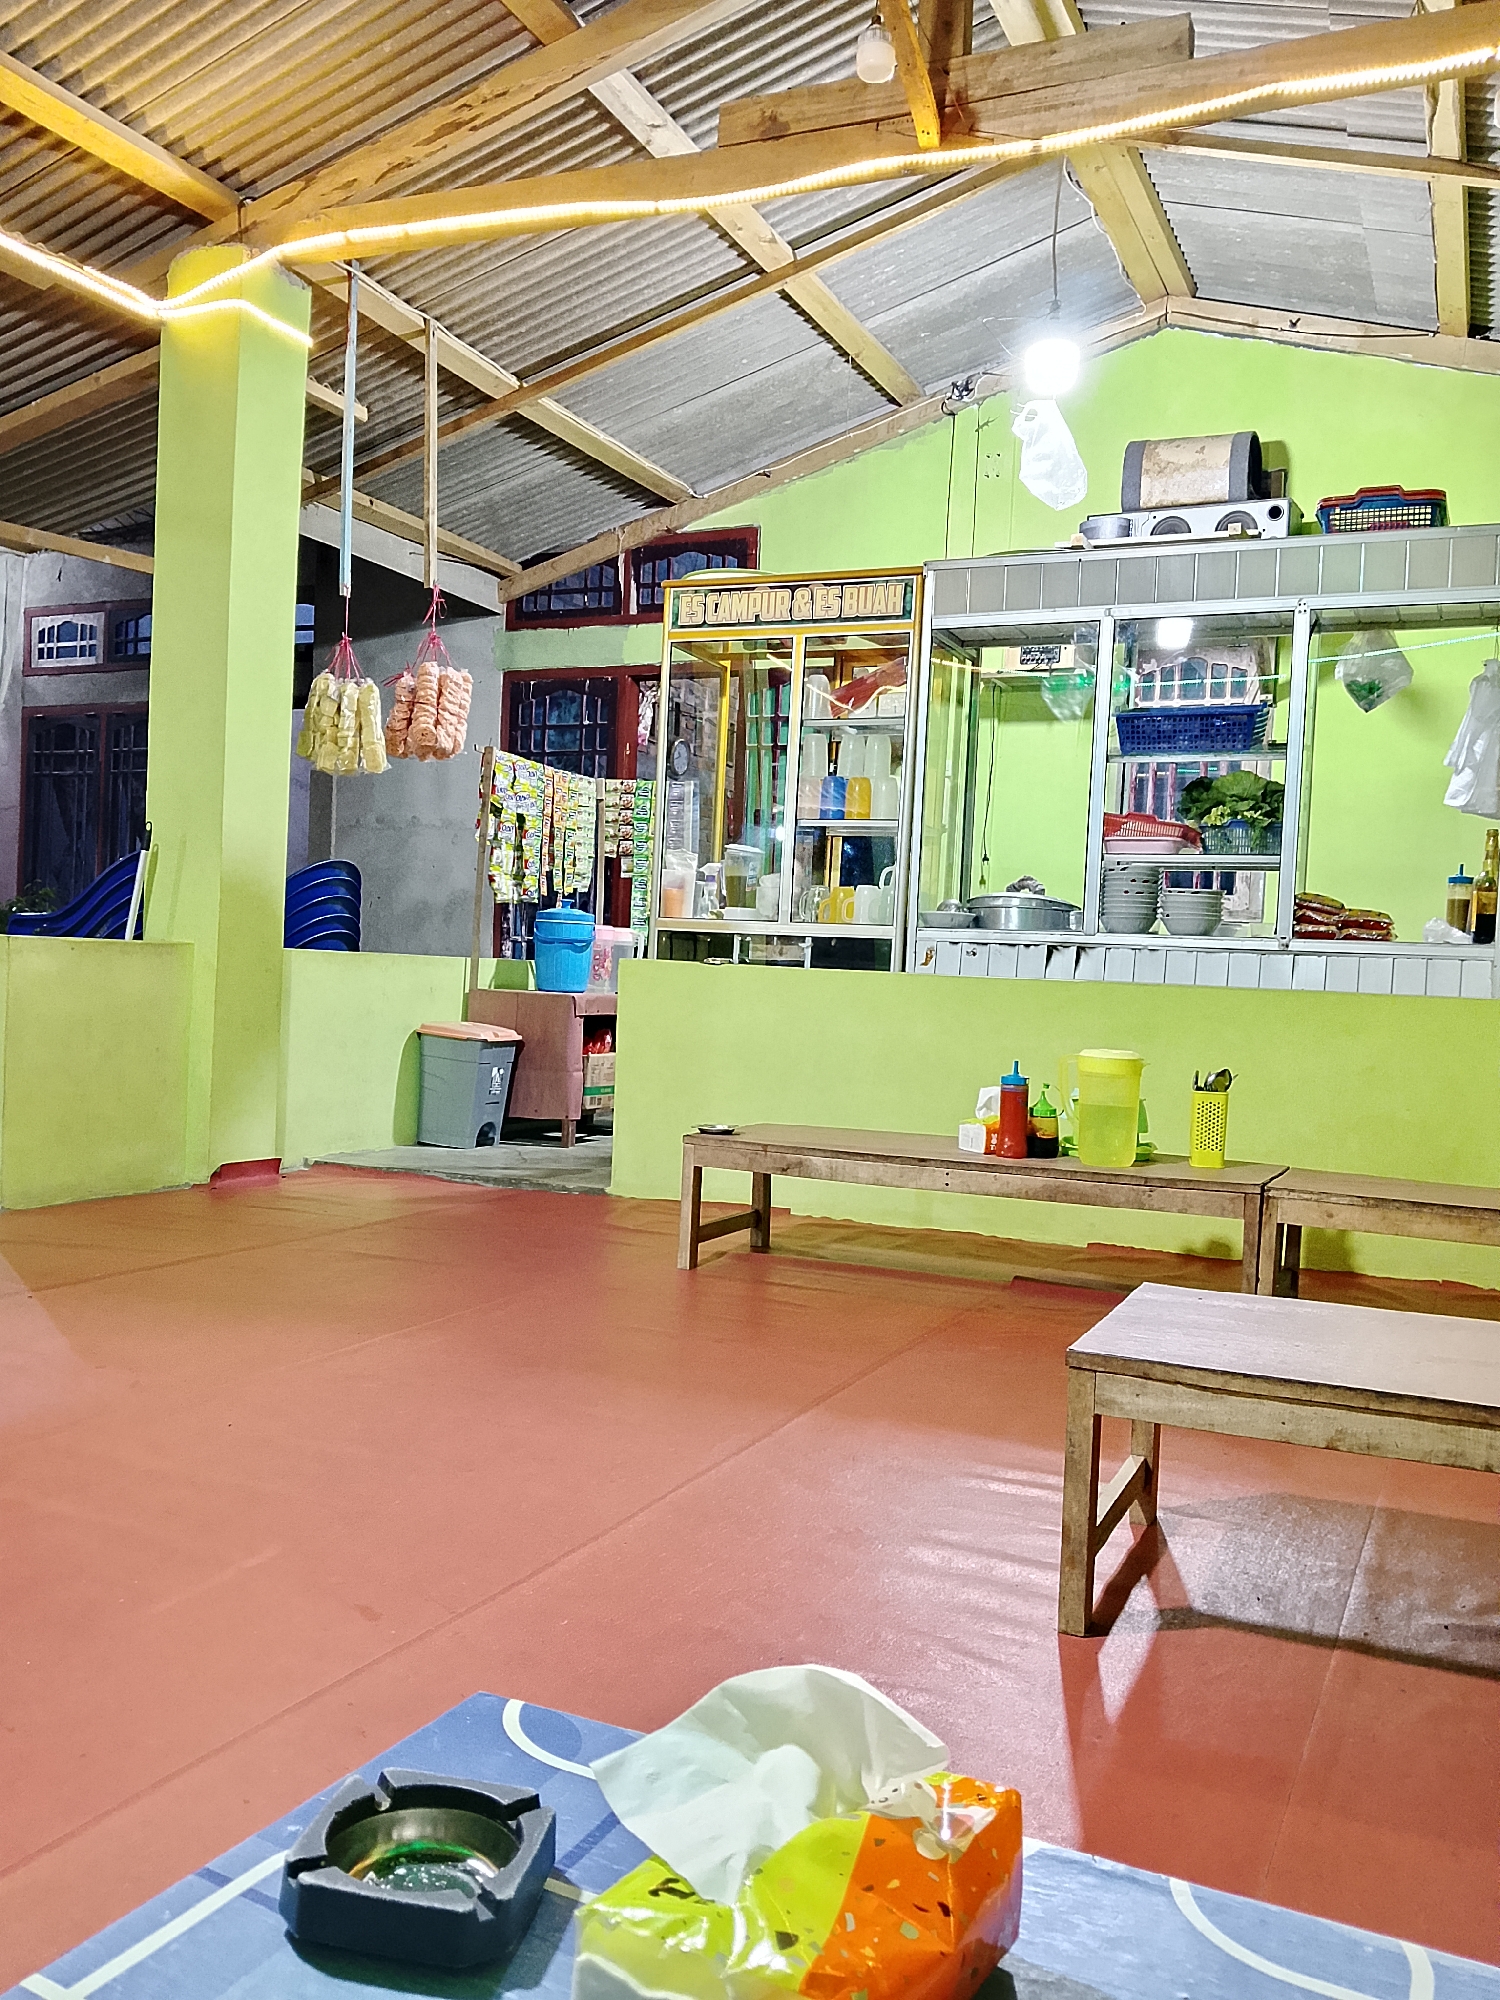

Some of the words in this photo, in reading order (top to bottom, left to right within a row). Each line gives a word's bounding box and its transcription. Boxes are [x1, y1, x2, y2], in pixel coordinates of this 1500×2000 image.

[678, 594, 705, 625] ES
[705, 590, 791, 624] CAMPUR
[791, 587, 813, 620] &
[813, 586, 841, 619] ES
[842, 584, 904, 617] BUAH
